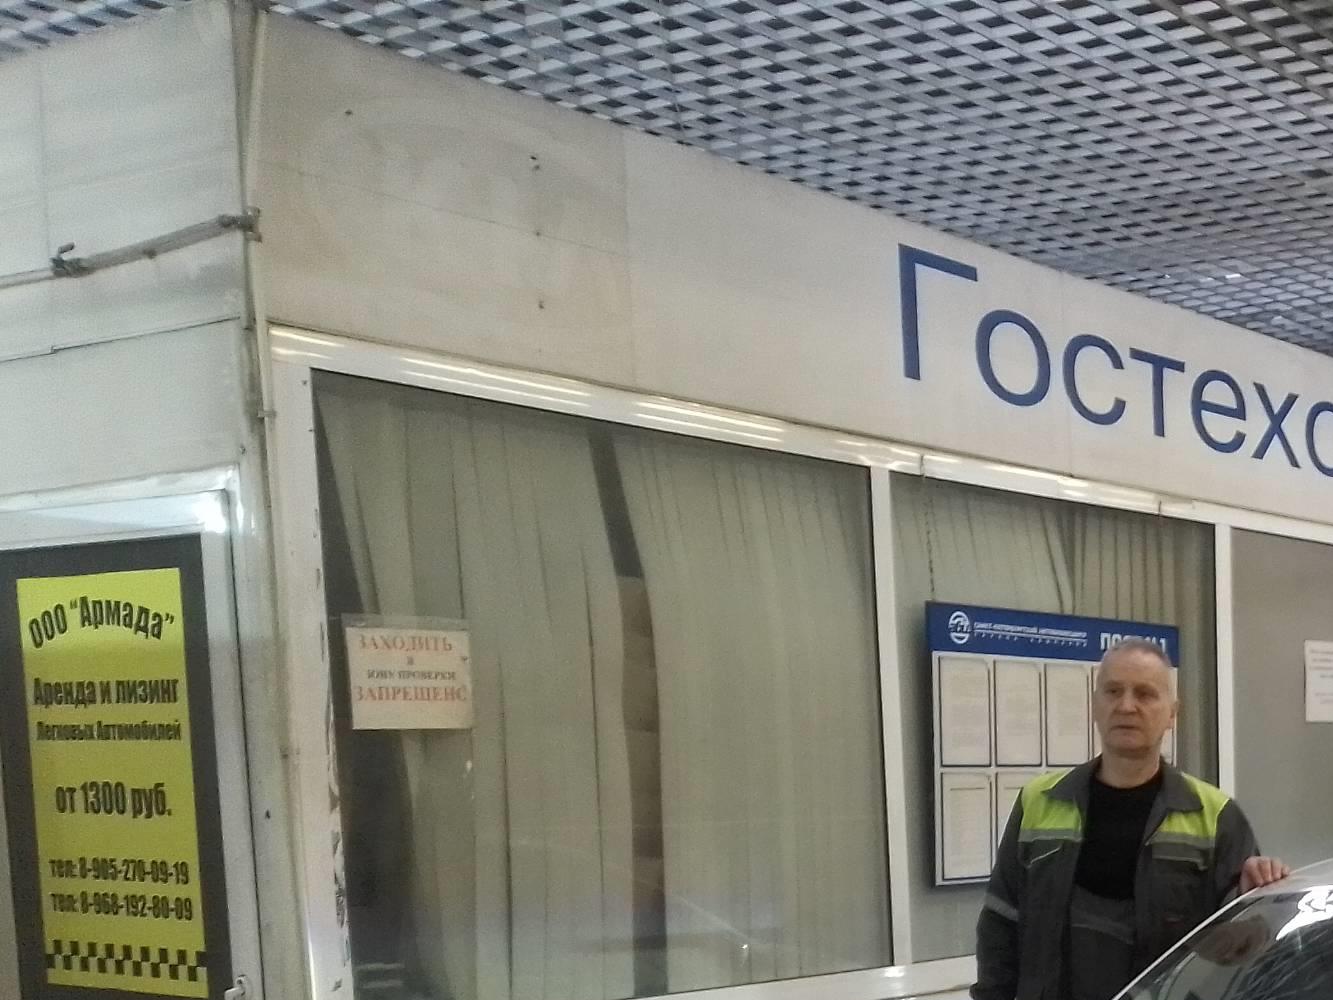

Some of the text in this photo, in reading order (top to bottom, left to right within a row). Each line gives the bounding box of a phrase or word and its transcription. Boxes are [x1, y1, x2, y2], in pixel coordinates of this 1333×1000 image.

[28, 603, 68, 649] ООО
[359, 634, 453, 652] ЗАХОДИТЬ
[398, 669, 456, 681] ПРОВЕРКИ
[33, 677, 180, 709] Аренда и лизинг
[357, 684, 467, 702] ЗАПРЕЩЕНО
[36, 718, 182, 743] Легковых Автомобилей
[55, 780, 172, 819] от 1300 руб.
